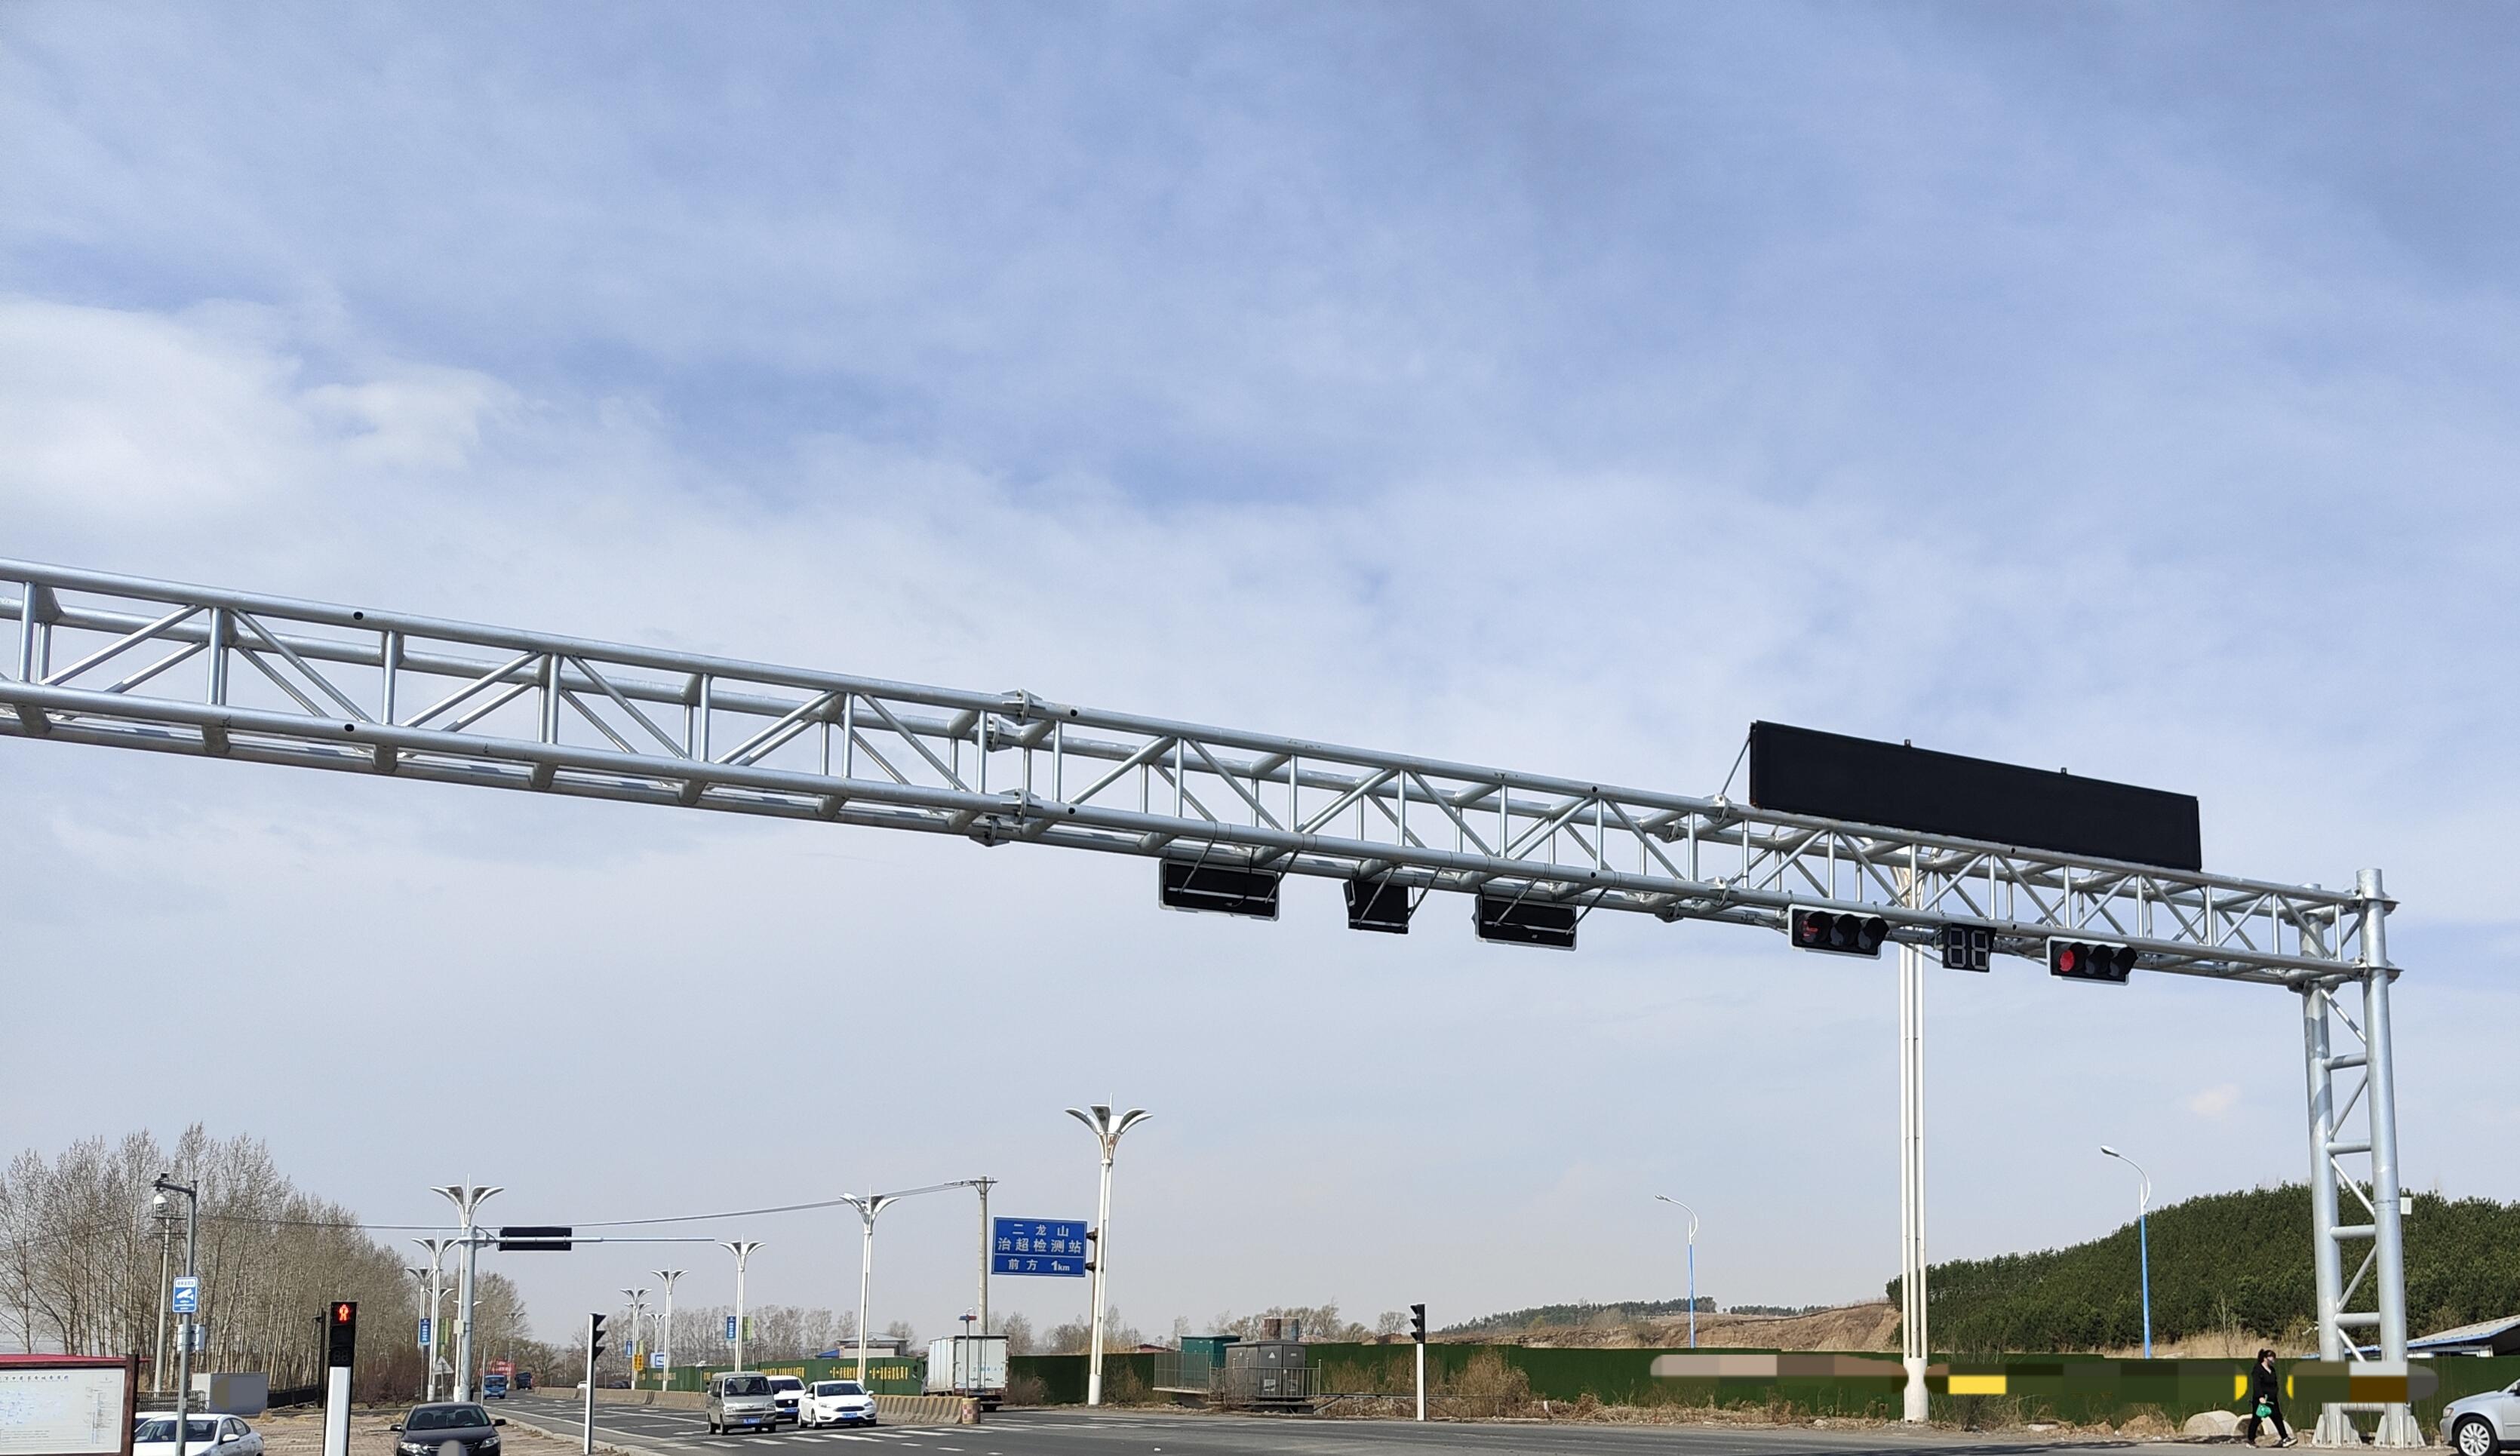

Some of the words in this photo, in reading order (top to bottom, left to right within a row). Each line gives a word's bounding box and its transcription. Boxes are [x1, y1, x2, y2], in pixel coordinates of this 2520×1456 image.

[1012, 1224, 1069, 1237] 二龙山
[997, 1237, 1082, 1254] 治超检测站
[1008, 1258, 1038, 1270] 前方
[1051, 1261, 1070, 1271] 1km
